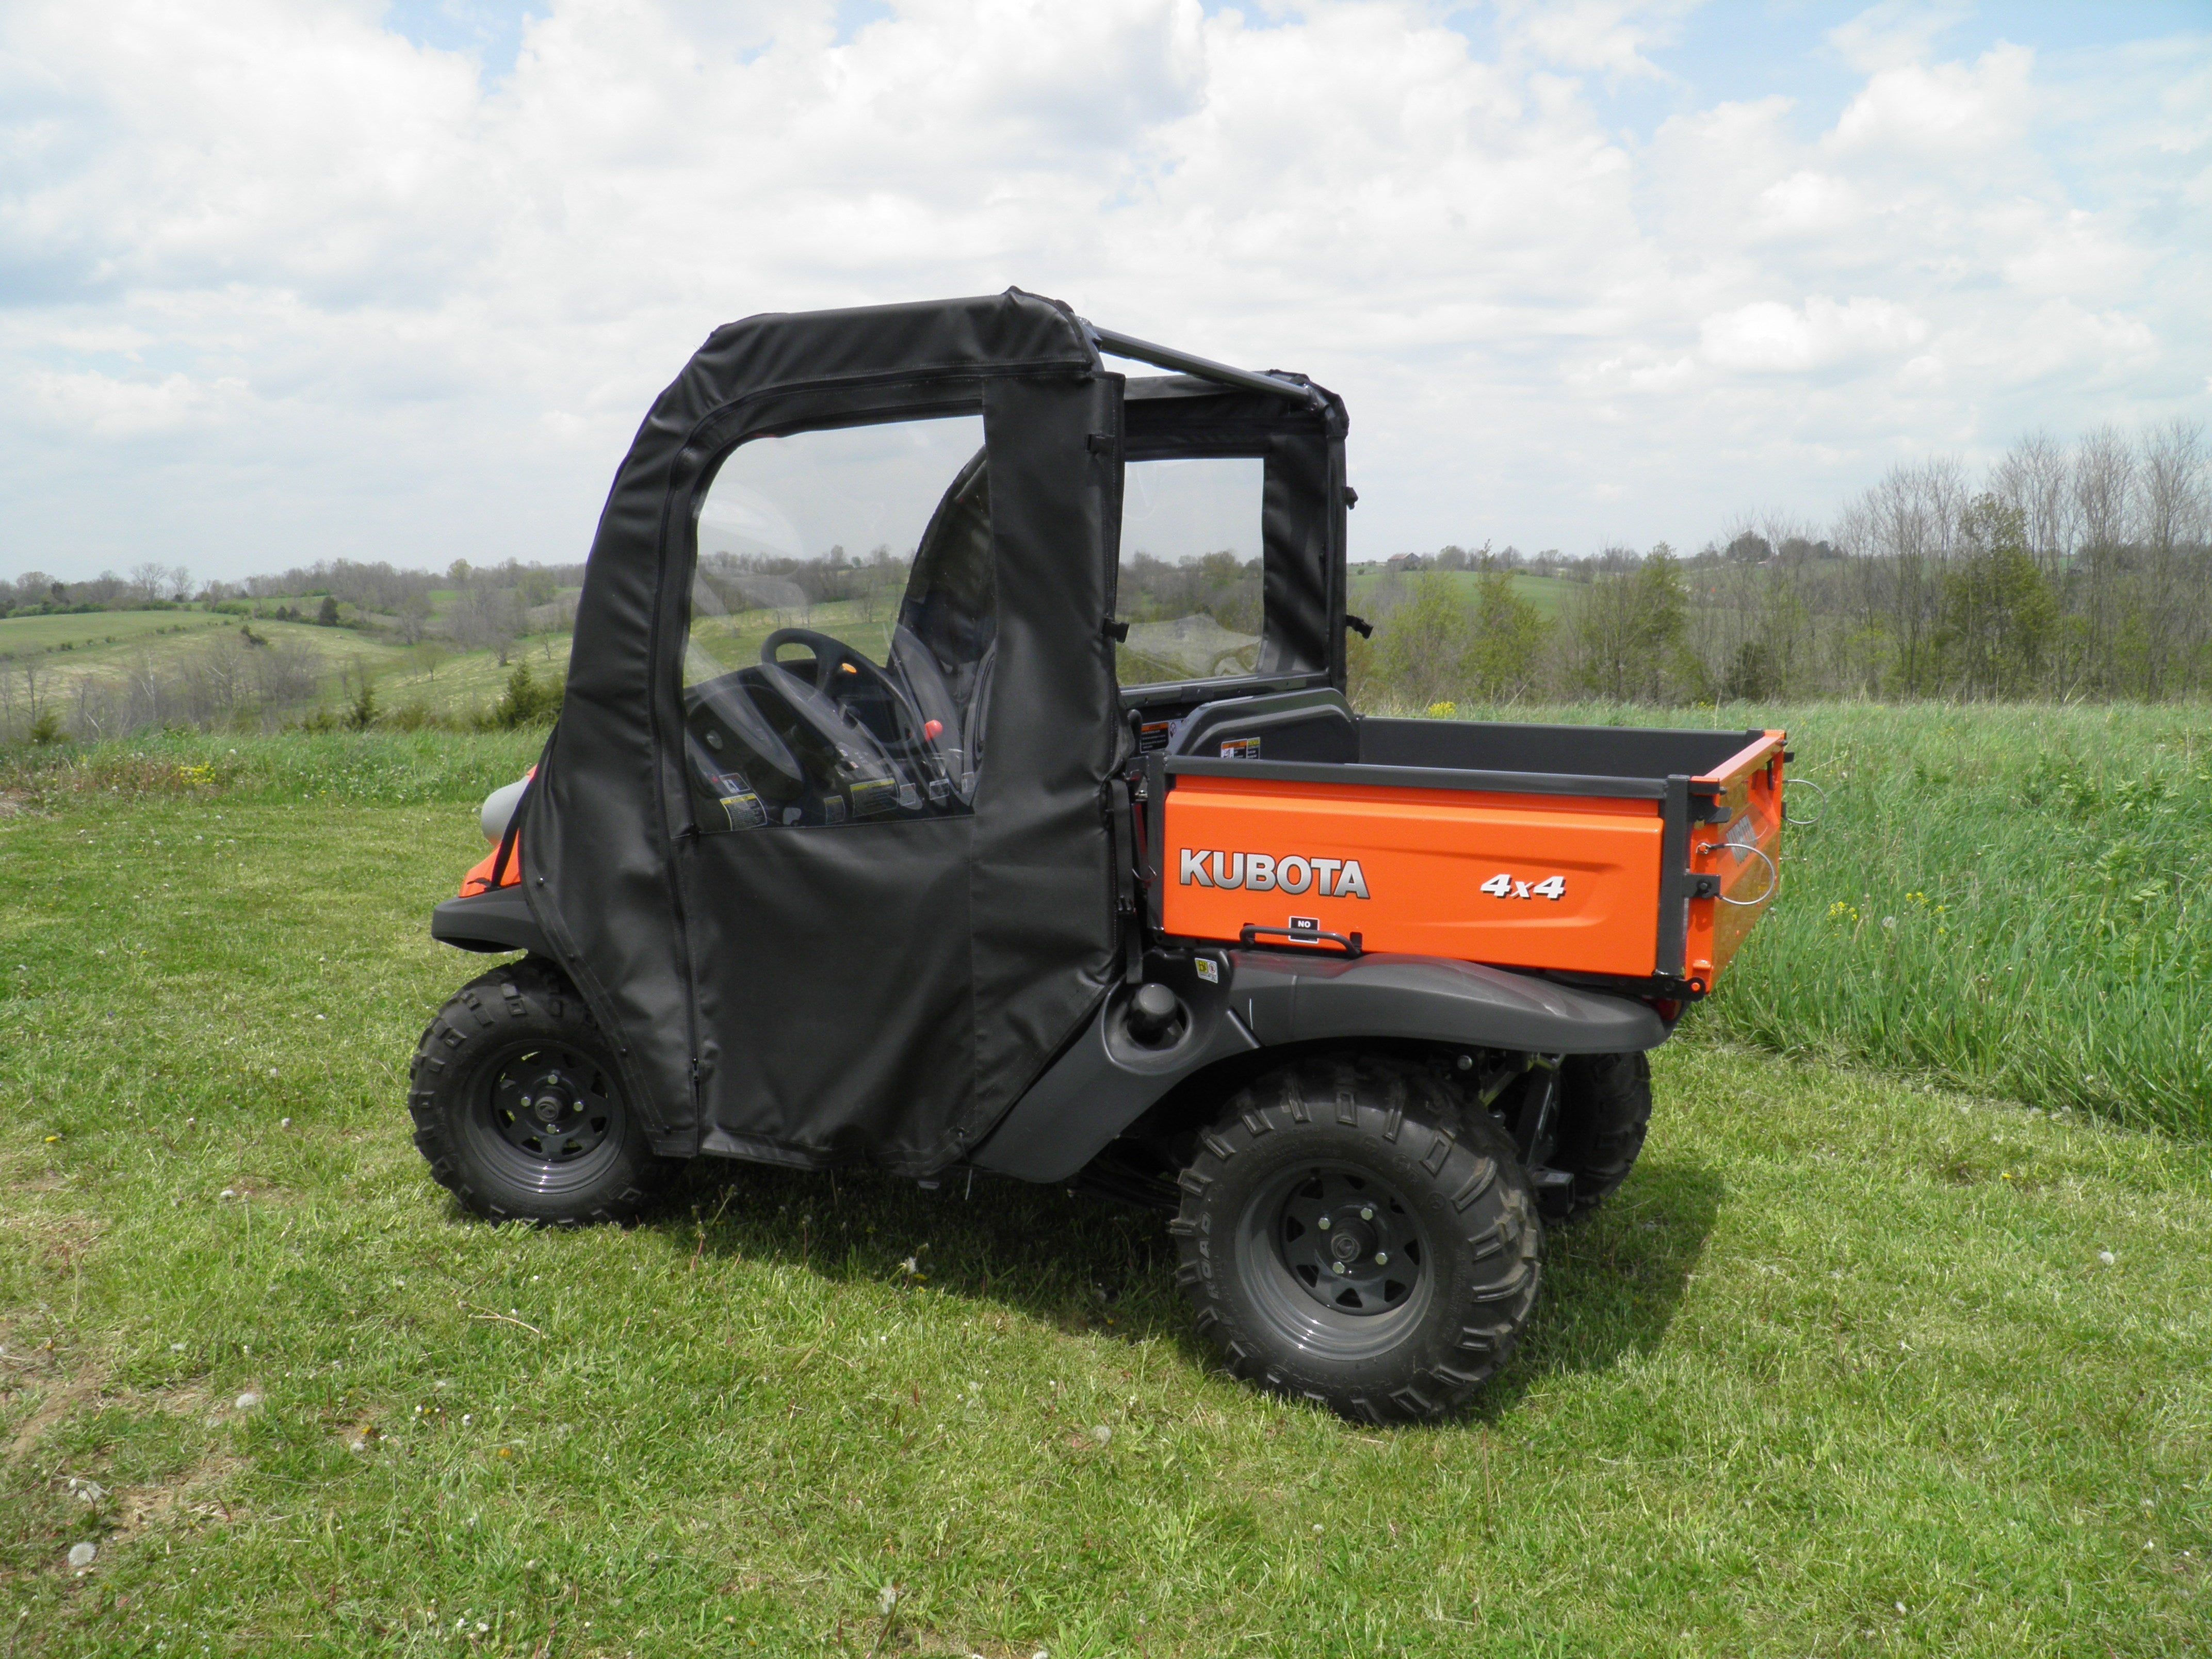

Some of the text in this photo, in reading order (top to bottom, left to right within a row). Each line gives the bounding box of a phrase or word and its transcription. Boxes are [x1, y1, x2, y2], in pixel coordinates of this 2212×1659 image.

[1180, 848, 1370, 899] KUBOTA
[1480, 874, 1566, 901] 4x4
[1199, 1212, 1219, 1299] ROAD
